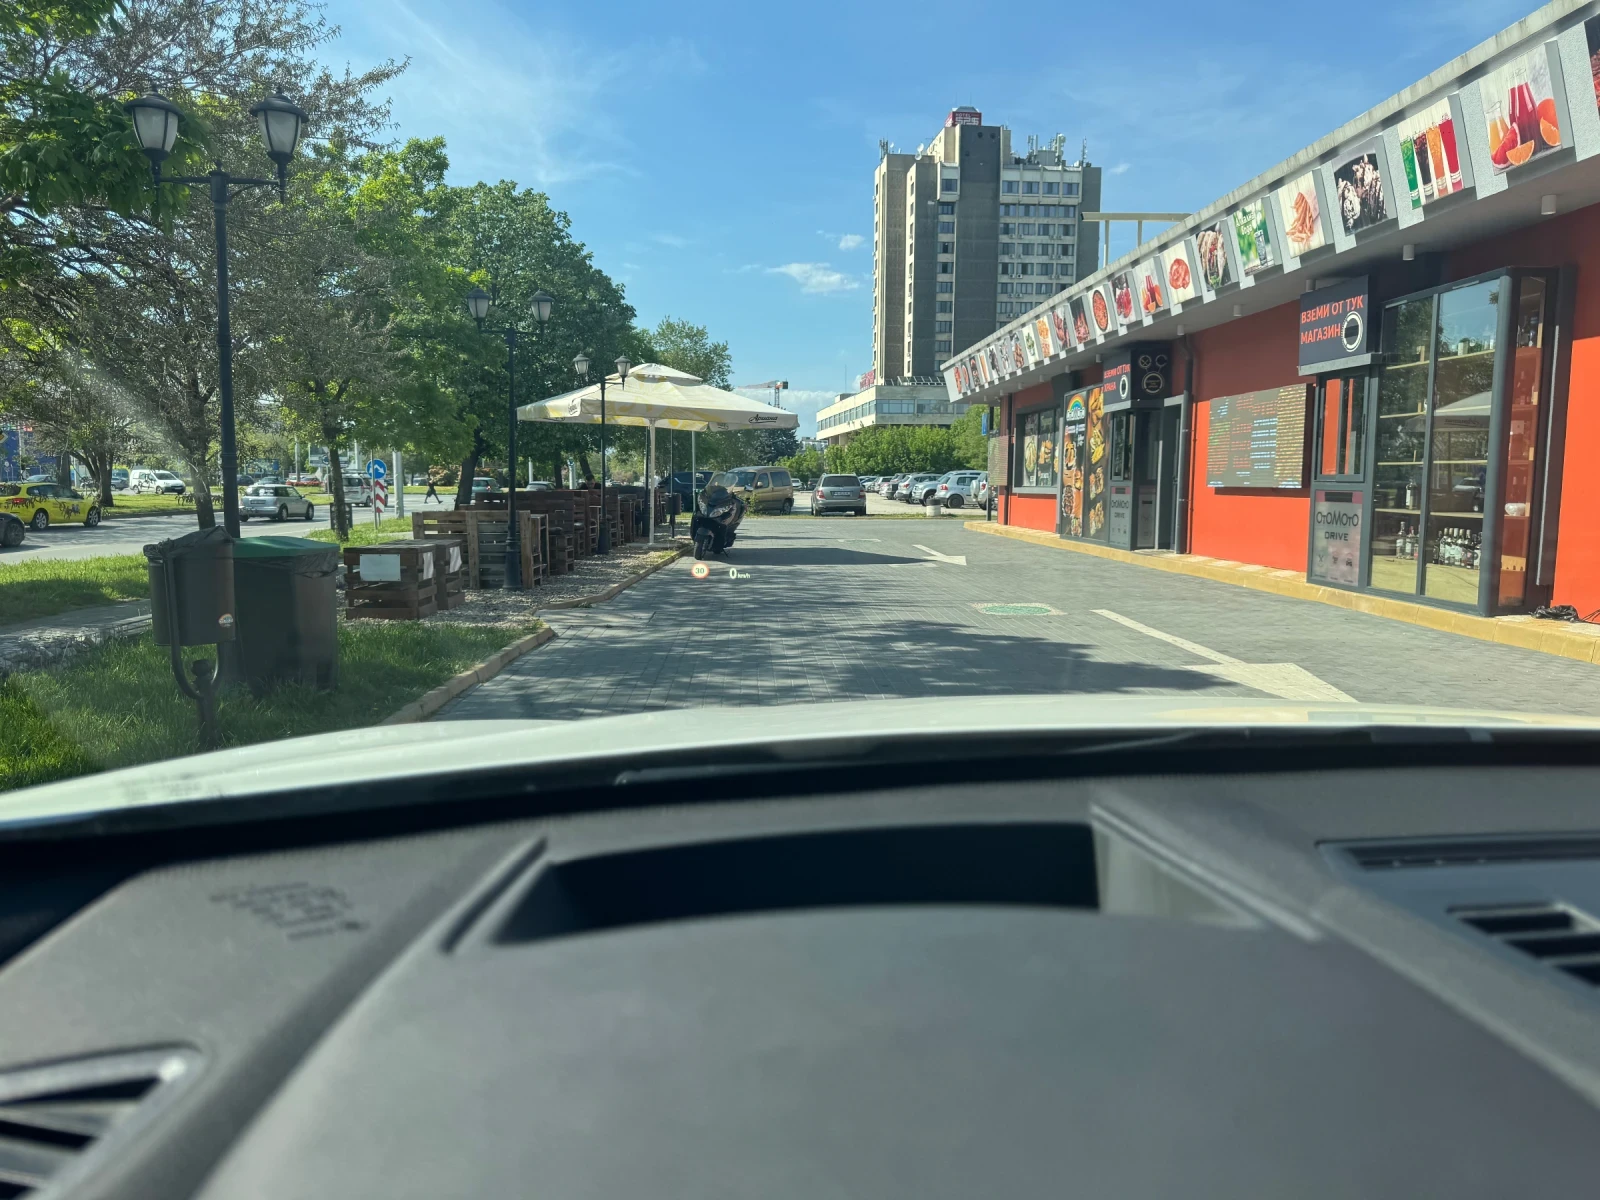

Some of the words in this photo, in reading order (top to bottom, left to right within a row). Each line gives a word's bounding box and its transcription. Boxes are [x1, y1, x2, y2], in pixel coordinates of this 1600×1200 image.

[1301, 304, 1330, 324] ВЗЕМИ
[1331, 301, 1344, 315] ОТ
[1345, 295, 1364, 312] ТУК
[1300, 323, 1341, 344] МАГАЗИН
[1324, 531, 1349, 541] DRIVE
[729, 568, 737, 579] 0
